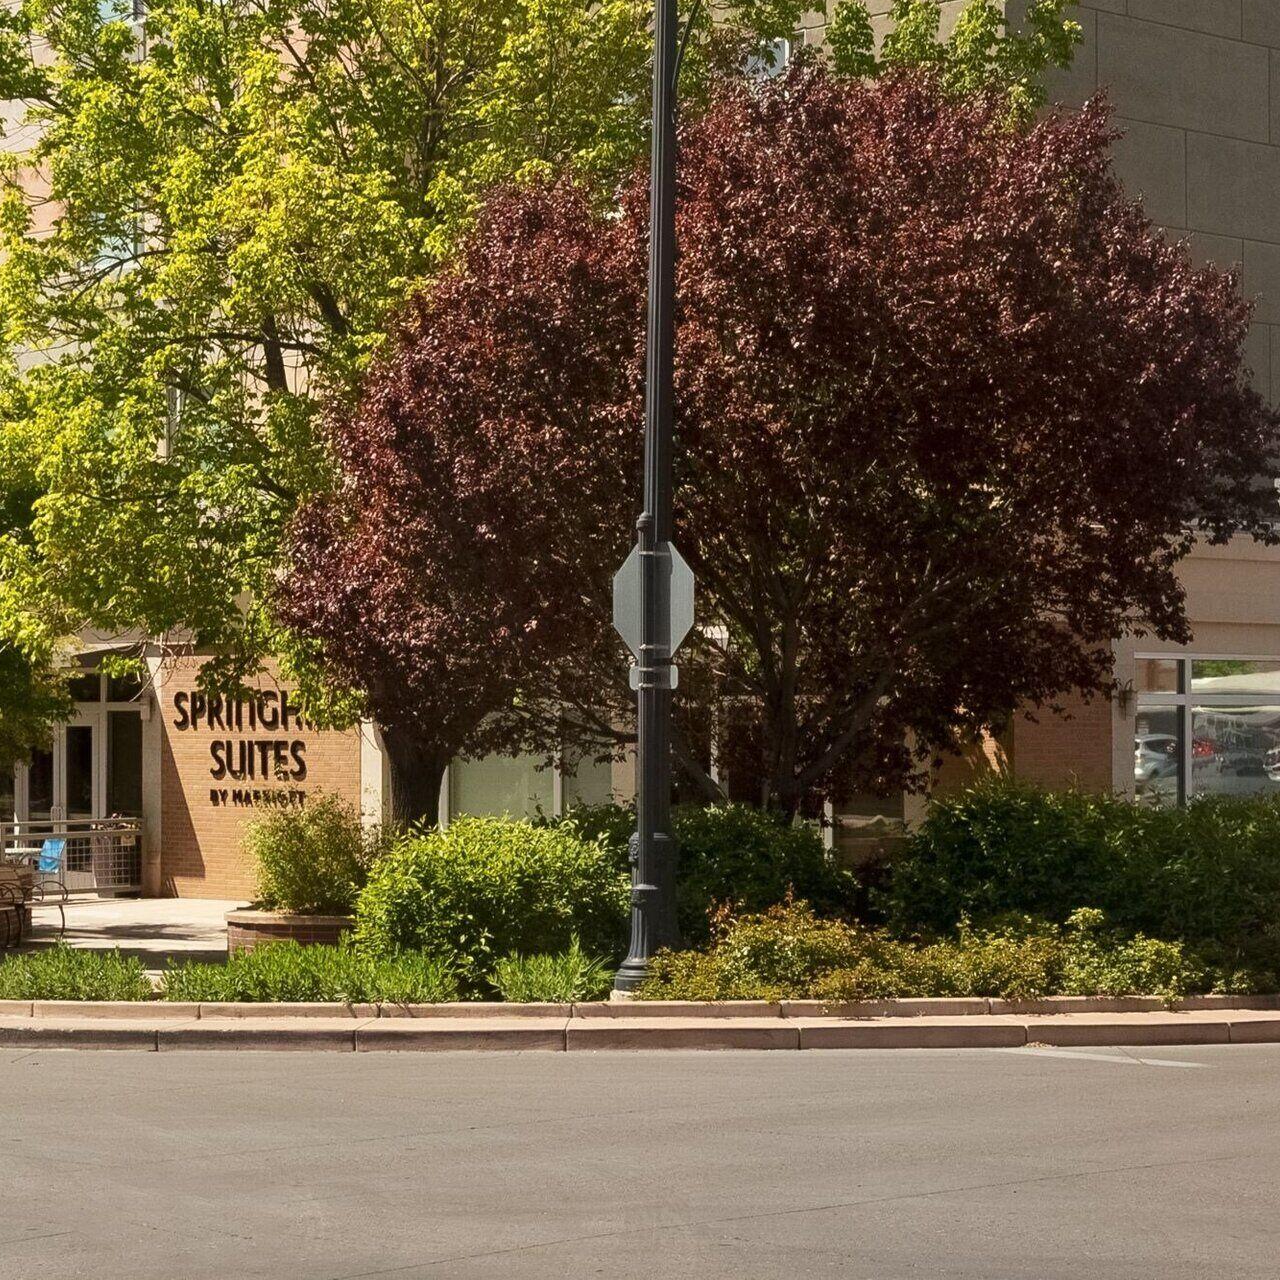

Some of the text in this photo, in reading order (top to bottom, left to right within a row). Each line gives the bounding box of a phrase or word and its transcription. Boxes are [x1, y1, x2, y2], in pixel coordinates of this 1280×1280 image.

[173, 690, 346, 731] SPRINGH
[210, 740, 307, 781] SUITES
[210, 789, 228, 807] BY
